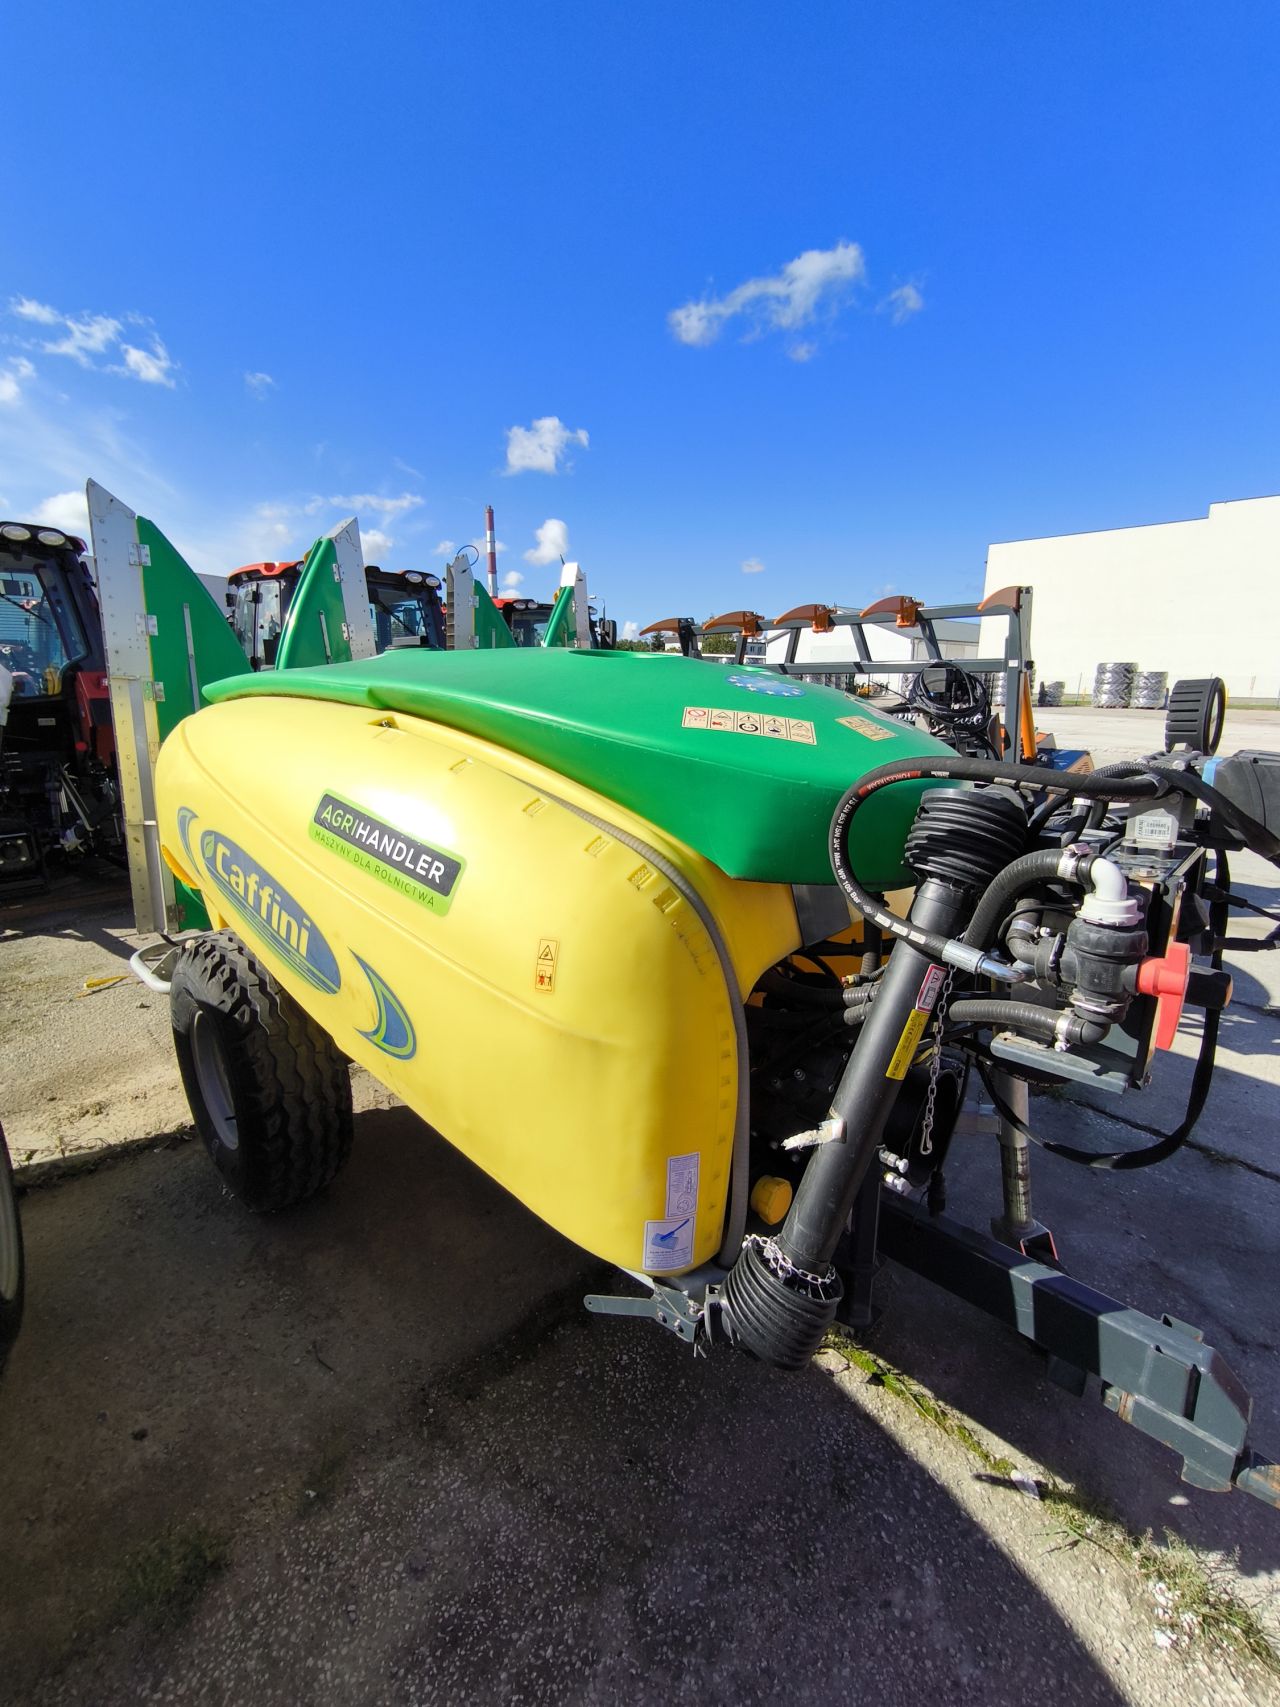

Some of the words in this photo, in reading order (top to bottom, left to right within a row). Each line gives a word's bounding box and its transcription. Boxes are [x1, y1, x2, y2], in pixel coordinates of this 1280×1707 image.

[315, 829, 351, 858] MASZYNY
[354, 851, 371, 870] DLA
[374, 864, 435, 908] ROLNICTWA
[320, 804, 445, 884] AGRIHANDLER
[215, 842, 311, 958] Caffini
[837, 868, 847, 880] WP
[842, 880, 854, 893] 105
[850, 891, 861, 904] Bar
